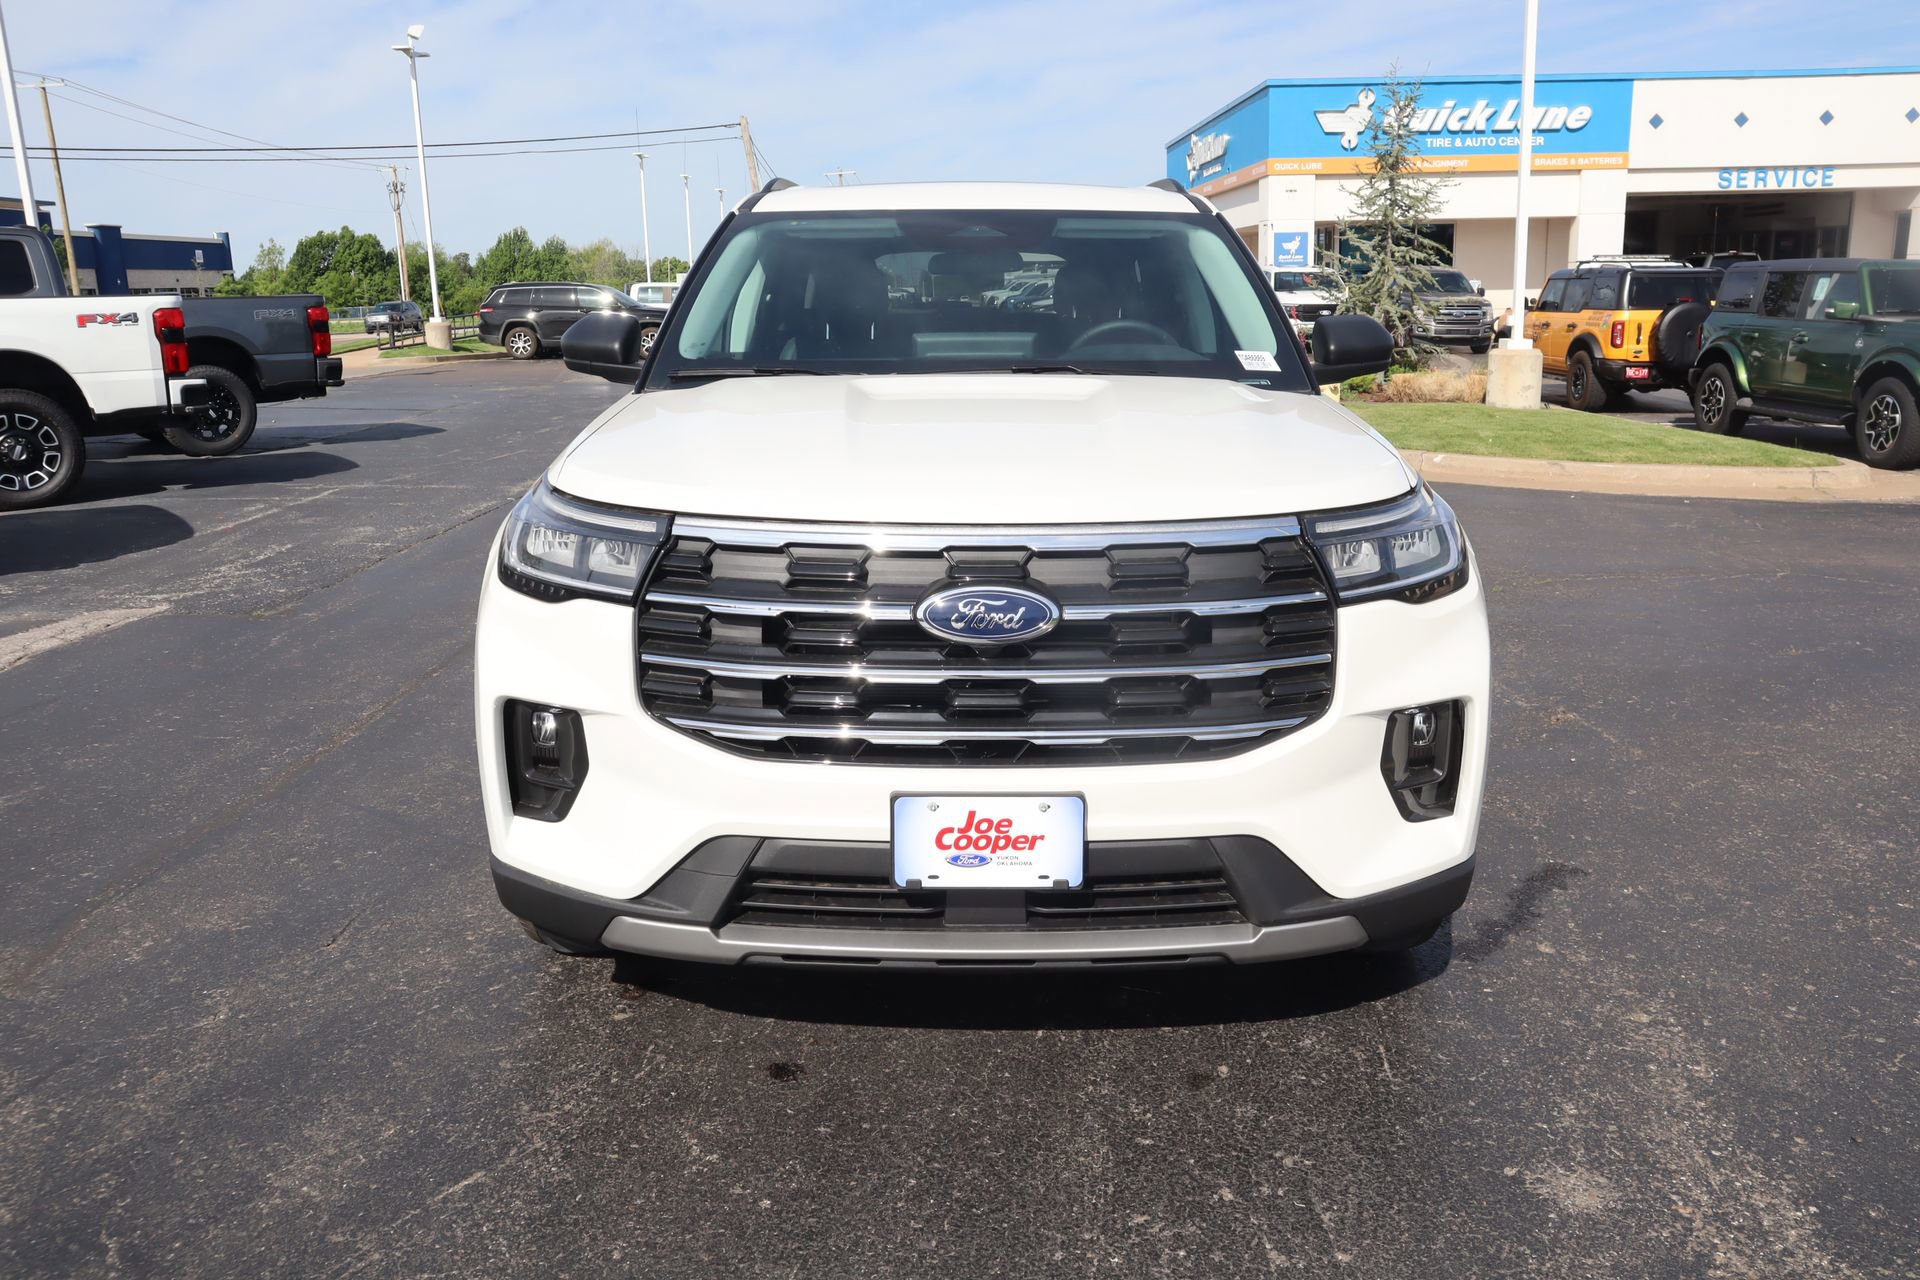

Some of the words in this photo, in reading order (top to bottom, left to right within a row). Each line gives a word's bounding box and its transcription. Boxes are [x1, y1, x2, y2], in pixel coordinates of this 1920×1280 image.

[1426, 138, 1451, 147] TIRE
[1454, 138, 1462, 147] &
[1465, 137, 1496, 146] AUTO
[1499, 136, 1544, 146] CENER
[1274, 162, 1299, 170] QUICK
[1301, 162, 1323, 170] LUBE
[1535, 158, 1569, 166] BRAKES
[1578, 157, 1623, 165] BATTERIES
[1717, 167, 1837, 189] SERVICE
[76, 312, 139, 328] FX4
[254, 309, 297, 320] FX4
[951, 598, 1026, 629] Ford
[957, 810, 1013, 834] Joe
[935, 827, 1045, 854] Cooper
